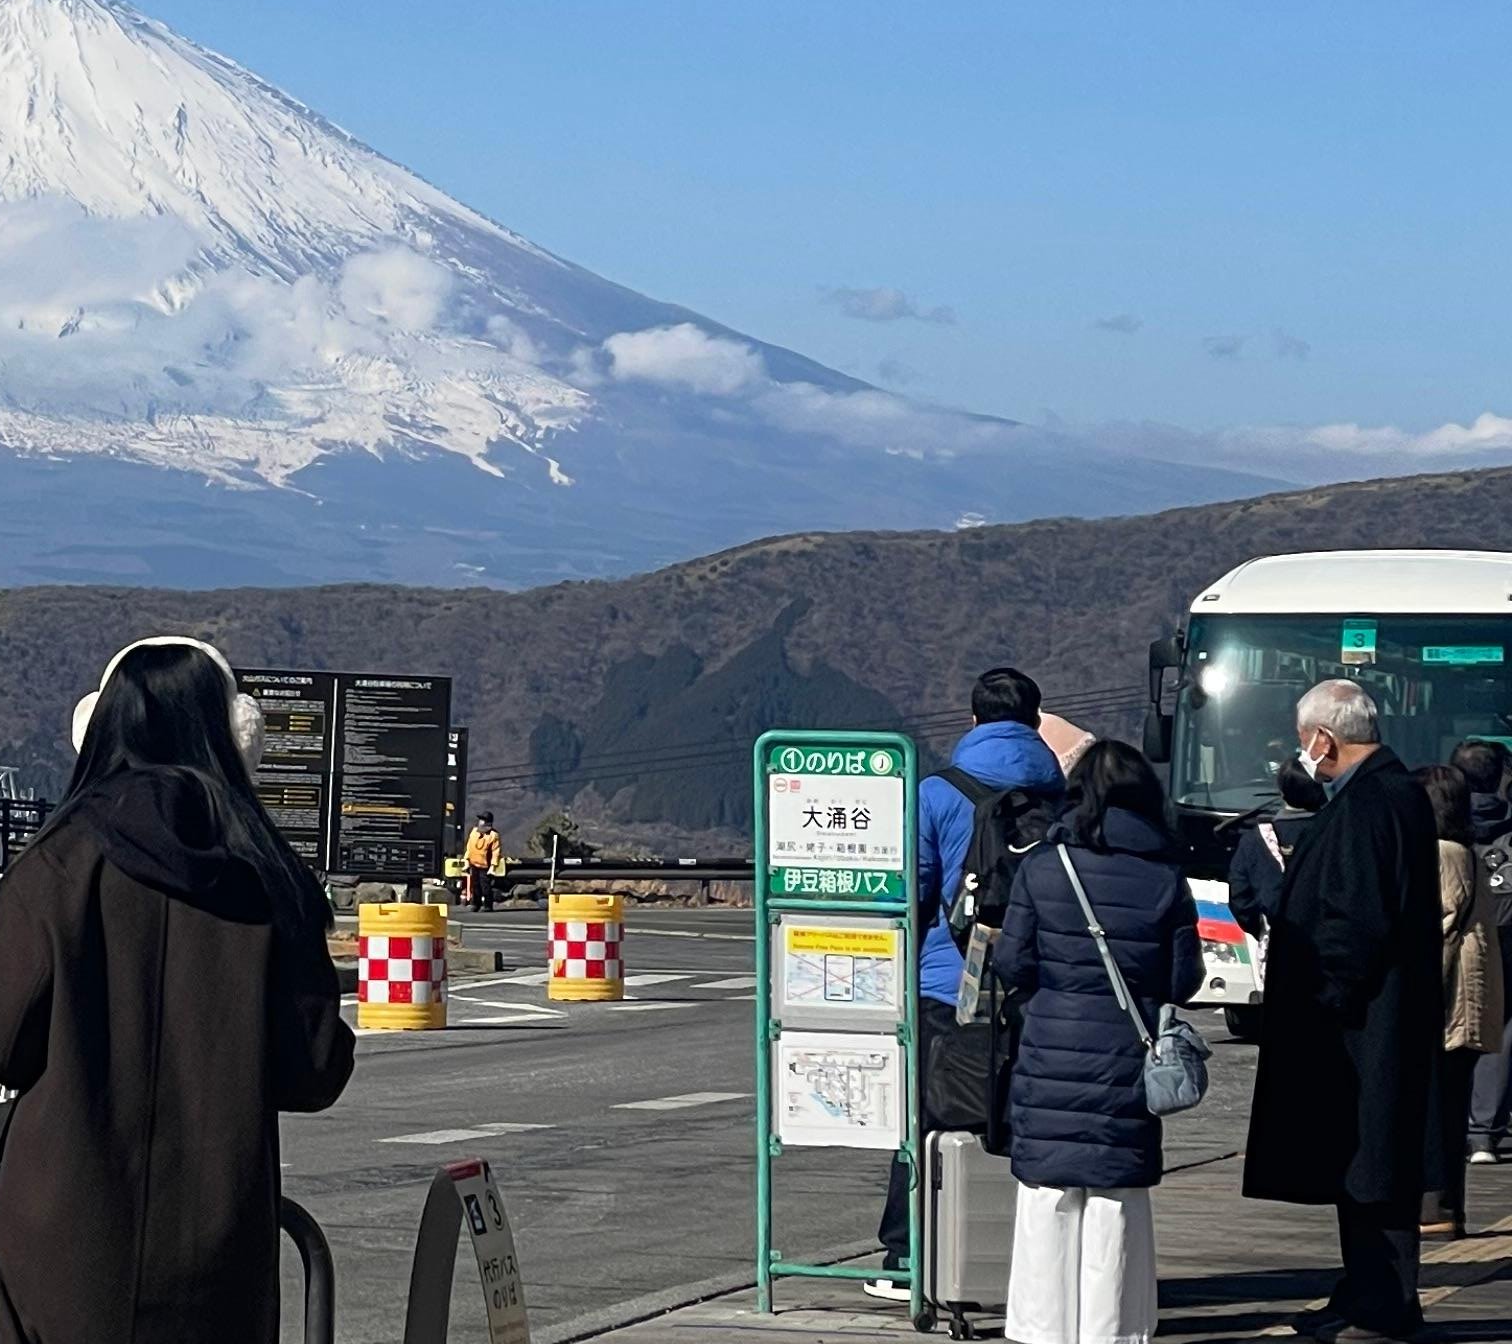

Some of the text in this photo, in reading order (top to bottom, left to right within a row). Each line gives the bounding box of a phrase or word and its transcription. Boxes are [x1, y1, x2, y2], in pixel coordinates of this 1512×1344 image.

[1352, 632, 1366, 648] 3
[802, 805, 872, 830] 大涌谷
[784, 867, 890, 894] 伊豆箱根バス
[493, 1281, 518, 1310] のりば
